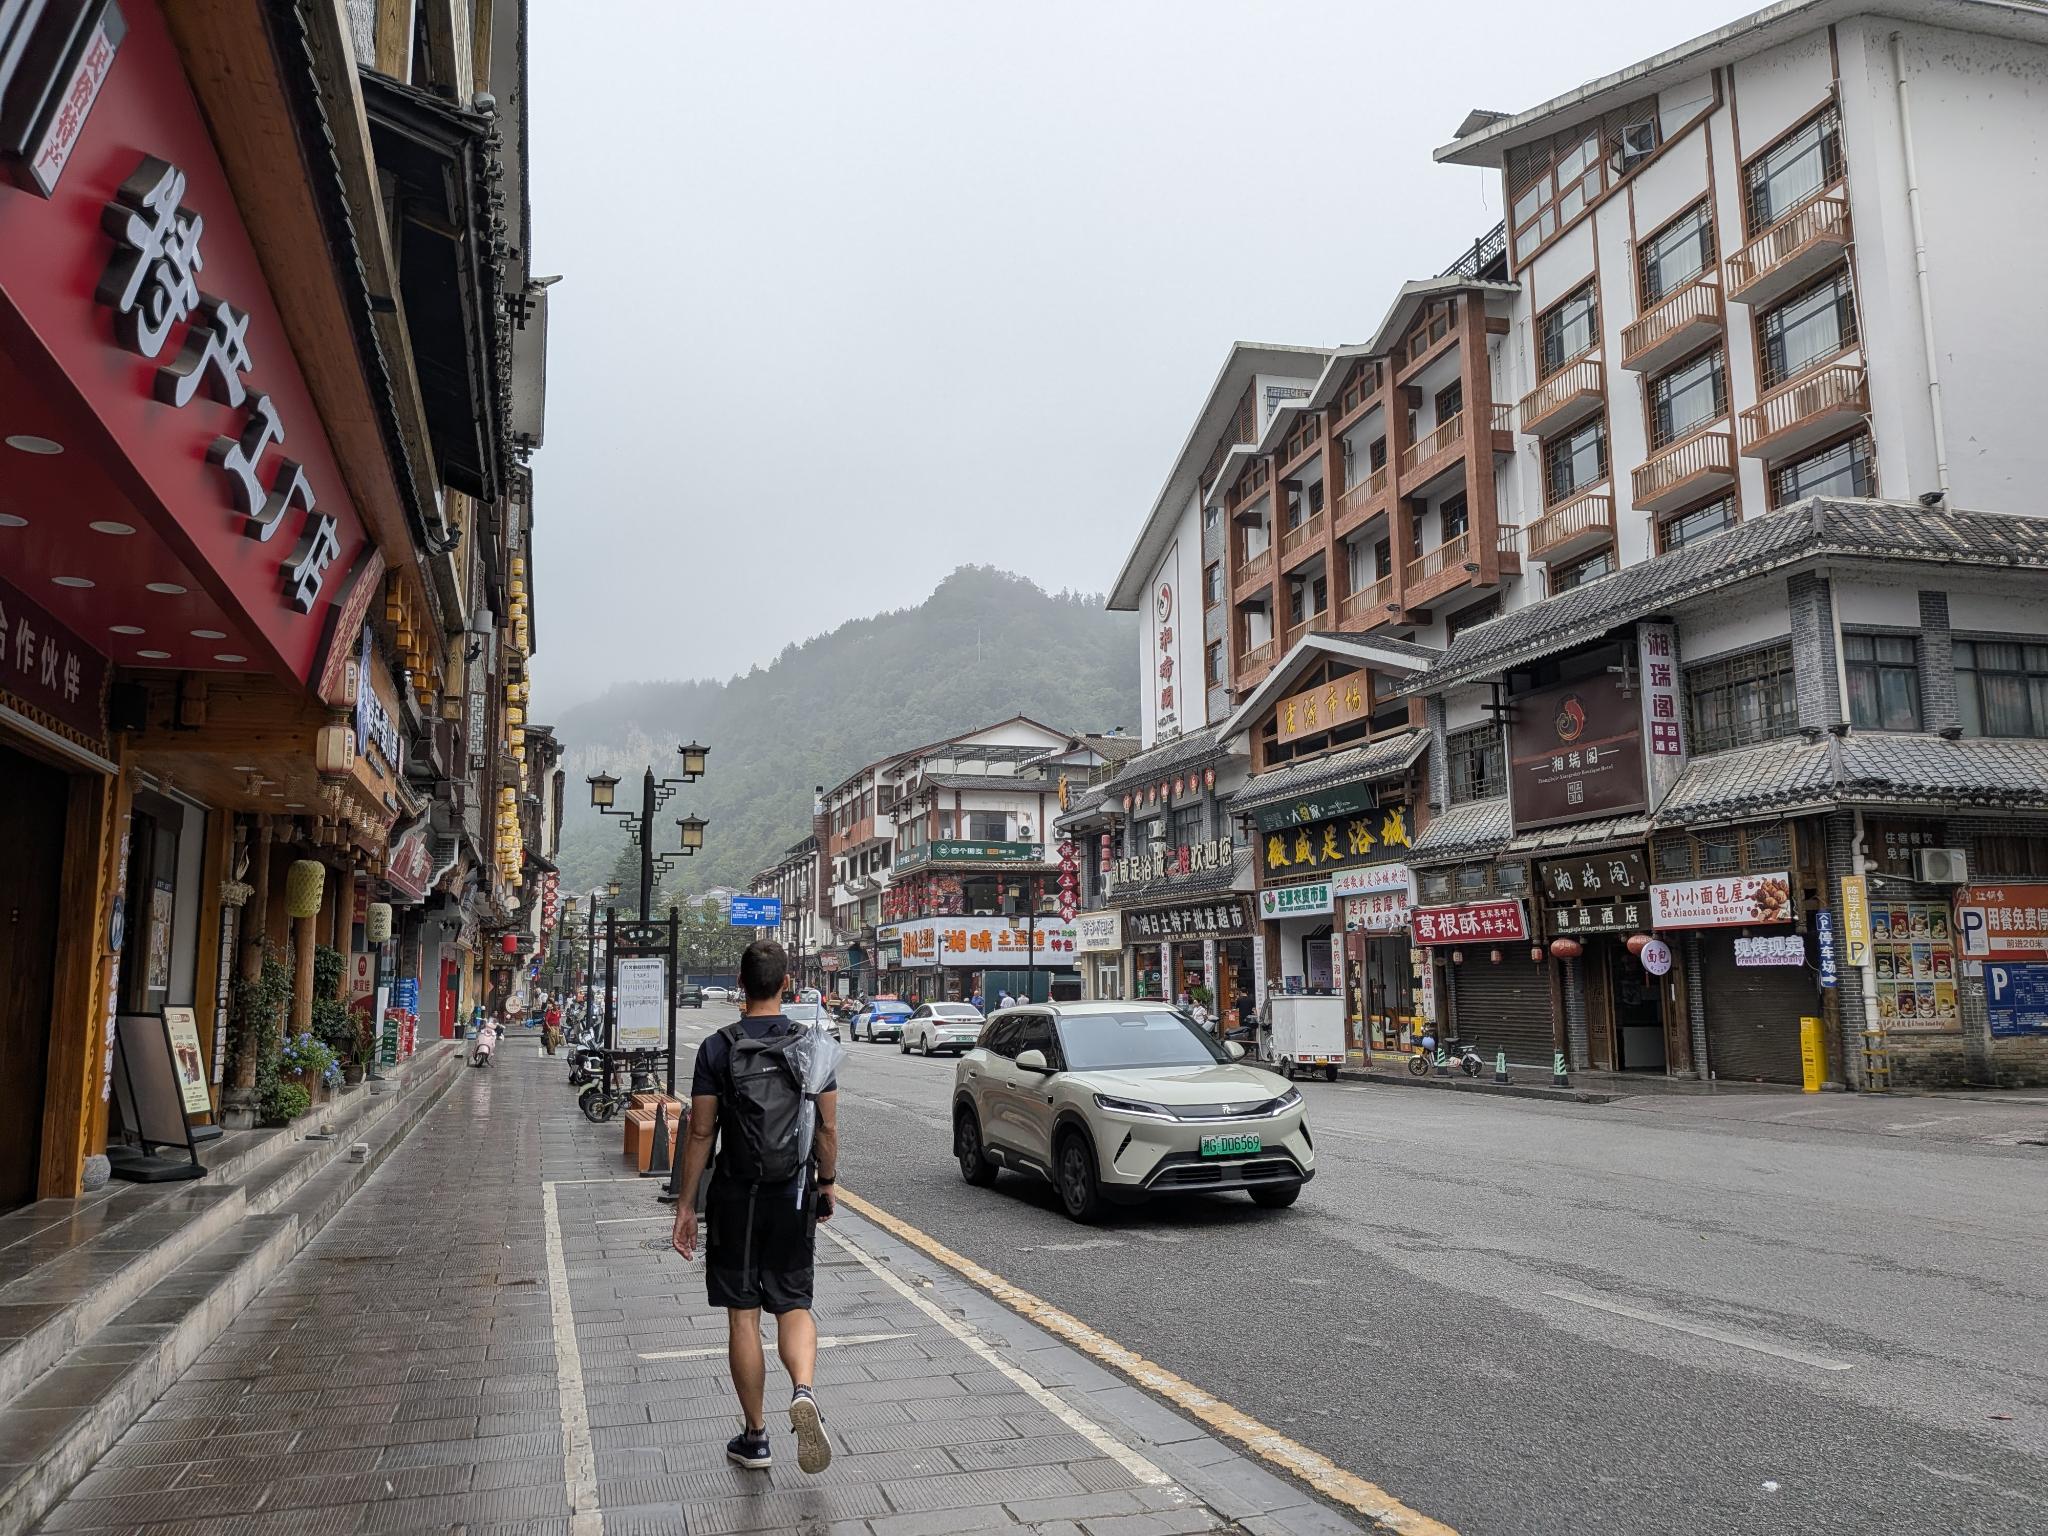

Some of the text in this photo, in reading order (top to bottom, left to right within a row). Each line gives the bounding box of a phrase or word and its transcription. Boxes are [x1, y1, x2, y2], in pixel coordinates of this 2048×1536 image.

[120, 166, 341, 614] 特产工厂店
[1648, 632, 1674, 717] 湘瑞阁
[1655, 725, 1676, 736] 精品
[1656, 740, 1677, 751] 酒店
[1552, 747, 1597, 772] 湘瑞阁
[1885, 832, 1933, 845] 住宿餐饮
[1554, 861, 1630, 892] 湘瑞阁
[1658, 883, 1744, 908] 葛小小面包屋
[1140, 905, 1243, 935] 鸿日土特产批发超市
[1557, 905, 1638, 927] 精品酒店
[1660, 904, 1744, 919] Ge Xiaoxiao Bakery
[1987, 907, 2048, 931] 用餐免费停
[1416, 910, 1481, 939] 葛根酥
[1482, 918, 1519, 934] 伴手礼
[1963, 911, 1983, 951] P
[1051, 939, 1077, 952] 特色
[1646, 949, 1670, 963] 面包
[1734, 935, 1804, 957] 现烤现卖
[1818, 931, 1836, 974] 停车场
[1850, 941, 1864, 961] P
[1737, 954, 1803, 966] Fresh Baked Daily
[1992, 968, 2008, 1000] P
